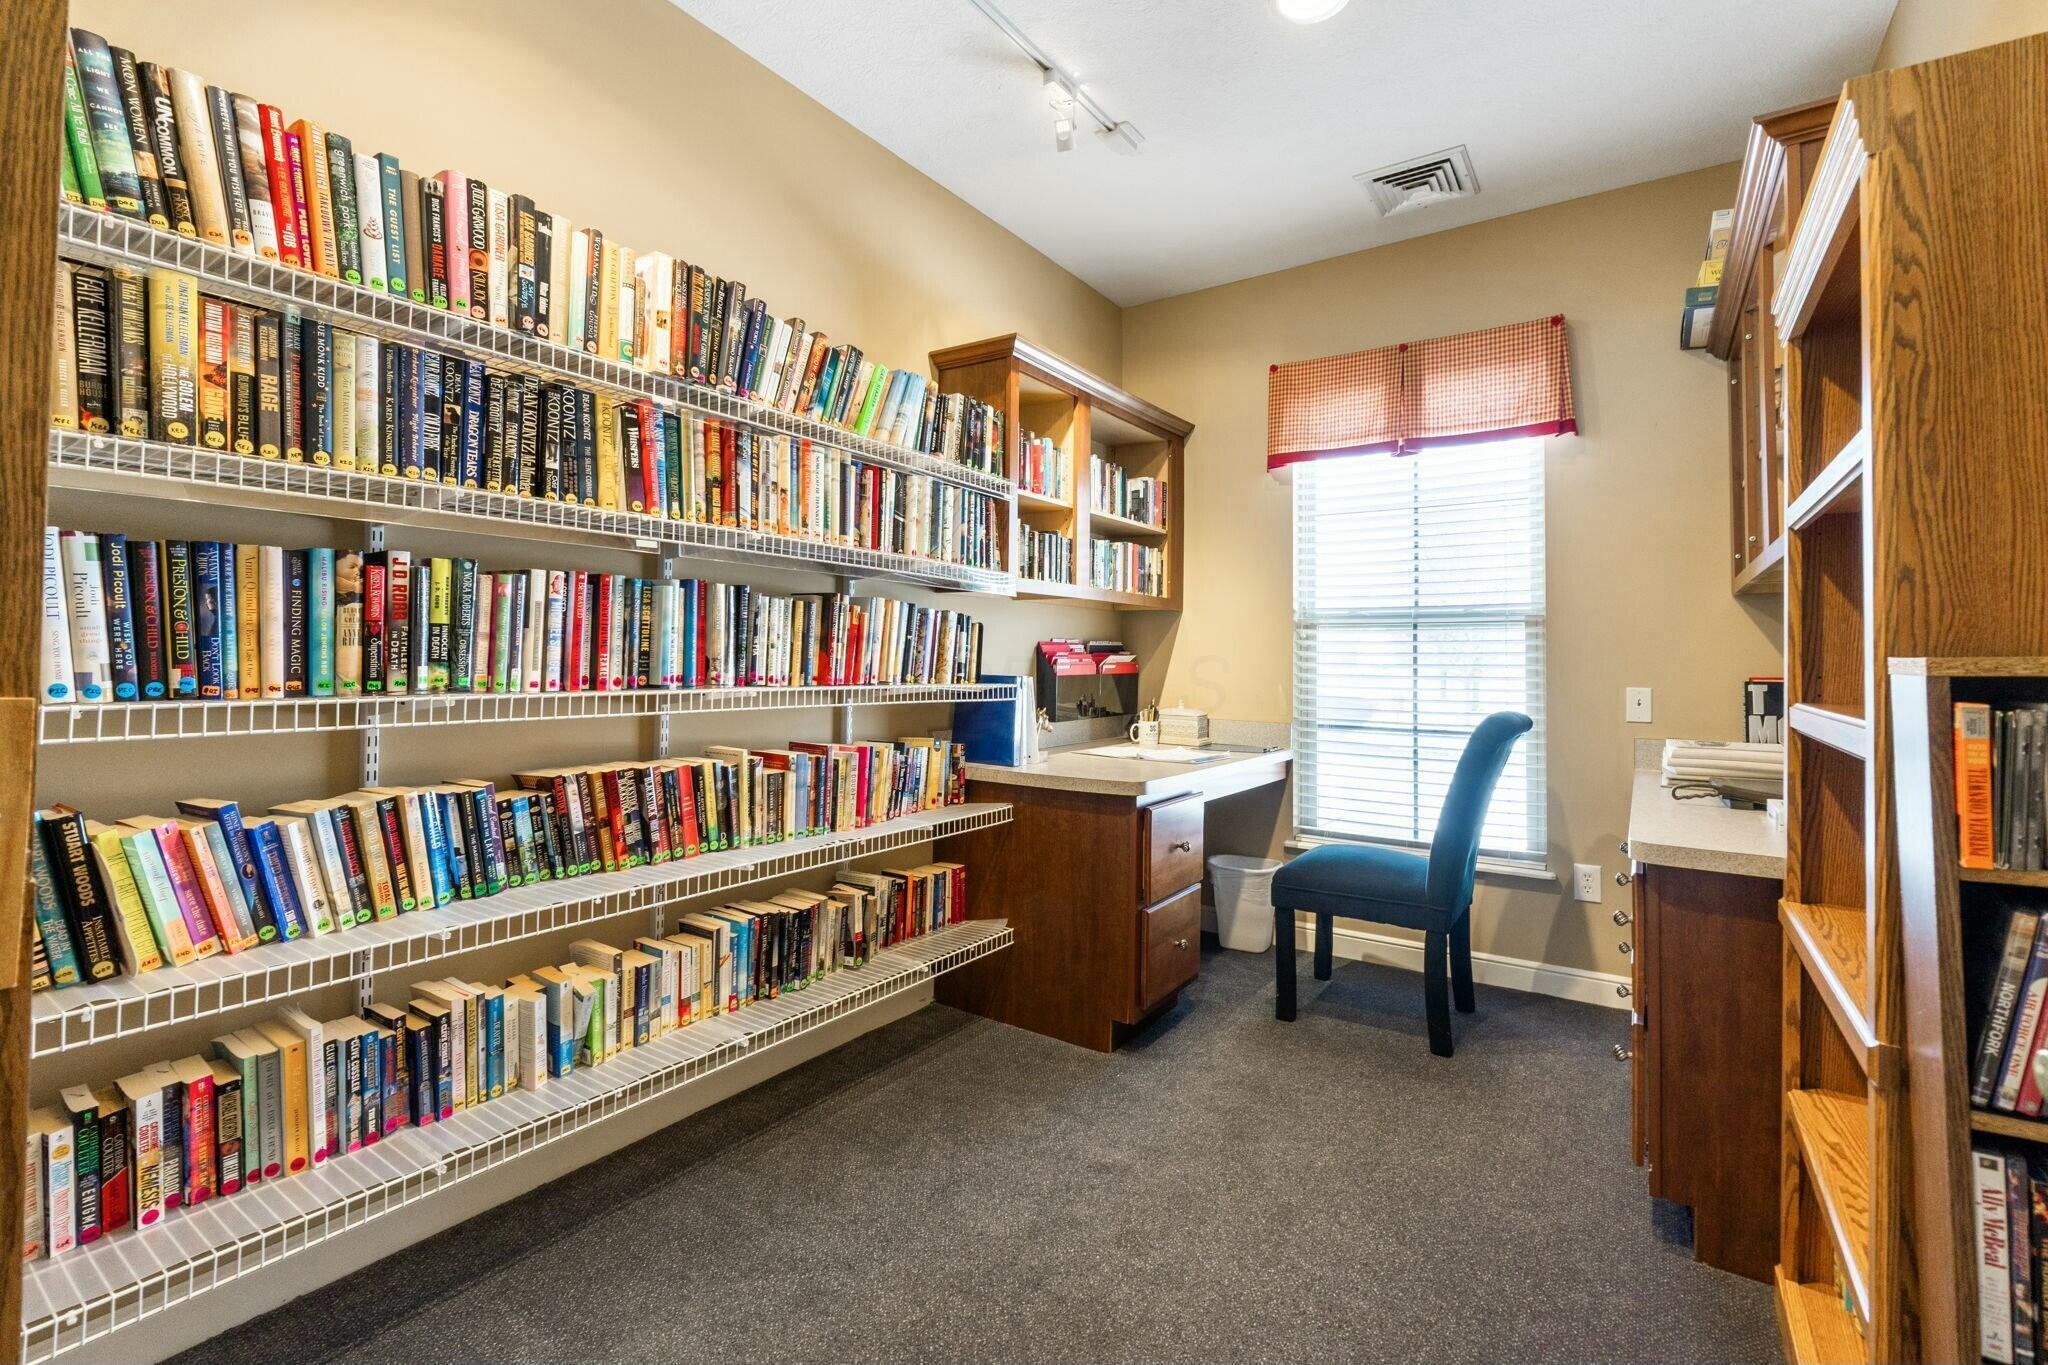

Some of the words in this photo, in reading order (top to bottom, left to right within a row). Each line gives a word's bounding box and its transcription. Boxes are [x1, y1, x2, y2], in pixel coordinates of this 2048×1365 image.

[86, 67, 111, 78] LIGHT
[120, 56, 137, 94] MOON
[97, 86, 109, 94] WE
[90, 103, 123, 115] CANNOT
[128, 97, 146, 144] WOMEN
[218, 98, 232, 131] CAREFUL
[104, 123, 118, 131] SEE
[154, 97, 178, 176] UNCOMMON
[224, 134, 236, 155] WHAT
[227, 159, 239, 174] YOU
[334, 149, 351, 201] greenwich
[143, 181, 154, 208] DUNCAN
[231, 177, 241, 196] WISH
[388, 188, 397, 204] THE
[470, 183, 485, 207] JULIE
[172, 192, 184, 221] DUNGY
[235, 198, 243, 214] FOR
[319, 192, 332, 233] TAKEDOWN
[340, 205, 351, 229] park
[431, 197, 440, 212] DICK
[298, 208, 308, 236] PLUM
[390, 209, 399, 239] GUEST
[473, 208, 486, 249] GARWOOD
[524, 213, 535, 231] LISA
[283, 229, 297, 249] JOB
[325, 236, 336, 269] TWENTY
[392, 244, 401, 264] LIST
[591, 236, 601, 269] WOMAN
[432, 243, 444, 279] DAMAGE
[77, 276, 105, 306] FAYE
[716, 290, 725, 319] BROKER
[122, 307, 144, 345] DREAMS
[238, 314, 250, 329] FAYE
[317, 321, 325, 337] SUE
[78, 307, 107, 376] KELLERMAN
[260, 325, 269, 360] KELLERMAN
[269, 327, 278, 357] JONATHAN
[317, 338, 325, 364] MONK
[179, 367, 189, 378] THE
[411, 348, 419, 374] Barbara
[162, 363, 177, 419] HOLLYWOOD
[317, 366, 325, 388] KIDD
[445, 361, 455, 402] KOONTZ
[490, 377, 500, 399] DEAN
[523, 376, 539, 408] DEAN
[179, 379, 194, 412] GOLEM
[261, 374, 279, 412] RAGE
[342, 390, 350, 426] MERMAID
[582, 394, 590, 412] DEAN
[386, 397, 394, 422] KAREN
[489, 400, 500, 433] KOONTZ
[547, 398, 560, 443] KOONTZ
[563, 388, 576, 440] KOONTZ
[468, 410, 480, 448] DRAGON
[522, 409, 537, 453] KOONTZ
[583, 413, 591, 440] KOONTZ
[601, 406, 612, 445] KOONTZ
[386, 424, 394, 463] KINGSBURY
[627, 427, 640, 468] WHISPERS
[467, 449, 478, 477] TEARS
[585, 476, 593, 498] CORNER
[45, 533, 55, 561] JODI
[111, 543, 124, 566] Jodi
[172, 559, 189, 607] PRESTON
[320, 556, 328, 581] MALIBU
[462, 571, 473, 592] NORA
[45, 566, 61, 620] PICOULT
[73, 572, 91, 620] Picoult
[89, 584, 100, 605] Jodi
[113, 570, 126, 609] Picoult
[643, 586, 651, 603] LISA
[225, 594, 233, 616] LIGHT
[291, 590, 302, 635] FINDING
[461, 594, 471, 626] ROBERTS
[113, 618, 122, 643] WERE
[123, 621, 132, 643] WISH
[175, 621, 189, 660] CHILD
[432, 627, 440, 635] IN
[440, 625, 448, 661] INNOCENT
[641, 605, 650, 652] SCOTTOLINE
[115, 647, 124, 670] HERE
[125, 648, 133, 667] YOU
[202, 650, 211, 672] BACK
[291, 639, 302, 674] MAGIC
[368, 637, 382, 678] Superstition
[391, 640, 399, 671] DEATH
[400, 626, 409, 674] FAITHLESS
[431, 637, 440, 659] DEATH
[211, 662, 221, 685] LOOK
[644, 776, 657, 818] BLACKSTOCK
[1968, 768, 1988, 816] CORNWELL
[229, 810, 240, 831] SIDNEY
[62, 822, 86, 864] STUART
[222, 813, 232, 830] AFTER
[231, 836, 243, 864] DARKNESS
[484, 837, 494, 858] LAKE
[1969, 818, 1989, 857] PATRICIA
[35, 864, 57, 911] WOODS
[73, 865, 95, 907] WOODS
[184, 889, 195, 907] save
[382, 881, 391, 903] TOTAL
[43, 918, 55, 933] THE
[190, 906, 201, 918] the
[195, 917, 208, 936] date
[55, 919, 68, 940] DEAD
[82, 921, 100, 963] APPETITES
[92, 915, 111, 960] INSATIABLE
[47, 935, 63, 960] WATER
[61, 942, 71, 951] IN
[2025, 991, 2038, 1012] AIR
[1984, 981, 2016, 1057] NORTHFORK
[2016, 1013, 2033, 1050] FORCE
[326, 1044, 336, 1064] CLIVE
[351, 1039, 361, 1059] CLIVE
[327, 1065, 336, 1098] CUSSLER
[351, 1060, 361, 1093] CUSSLER
[422, 1057, 430, 1081] CUSSLER
[139, 1124, 150, 1155] COULTER
[149, 1121, 159, 1151] CATHERINE
[78, 1128, 90, 1176] COULTER
[102, 1137, 113, 1177] COULTER
[113, 1133, 125, 1172] CATHERINE
[141, 1164, 160, 1210] NEMESIS
[165, 1158, 180, 1198] PARADOX
[82, 1189, 96, 1231] ENIGMA
